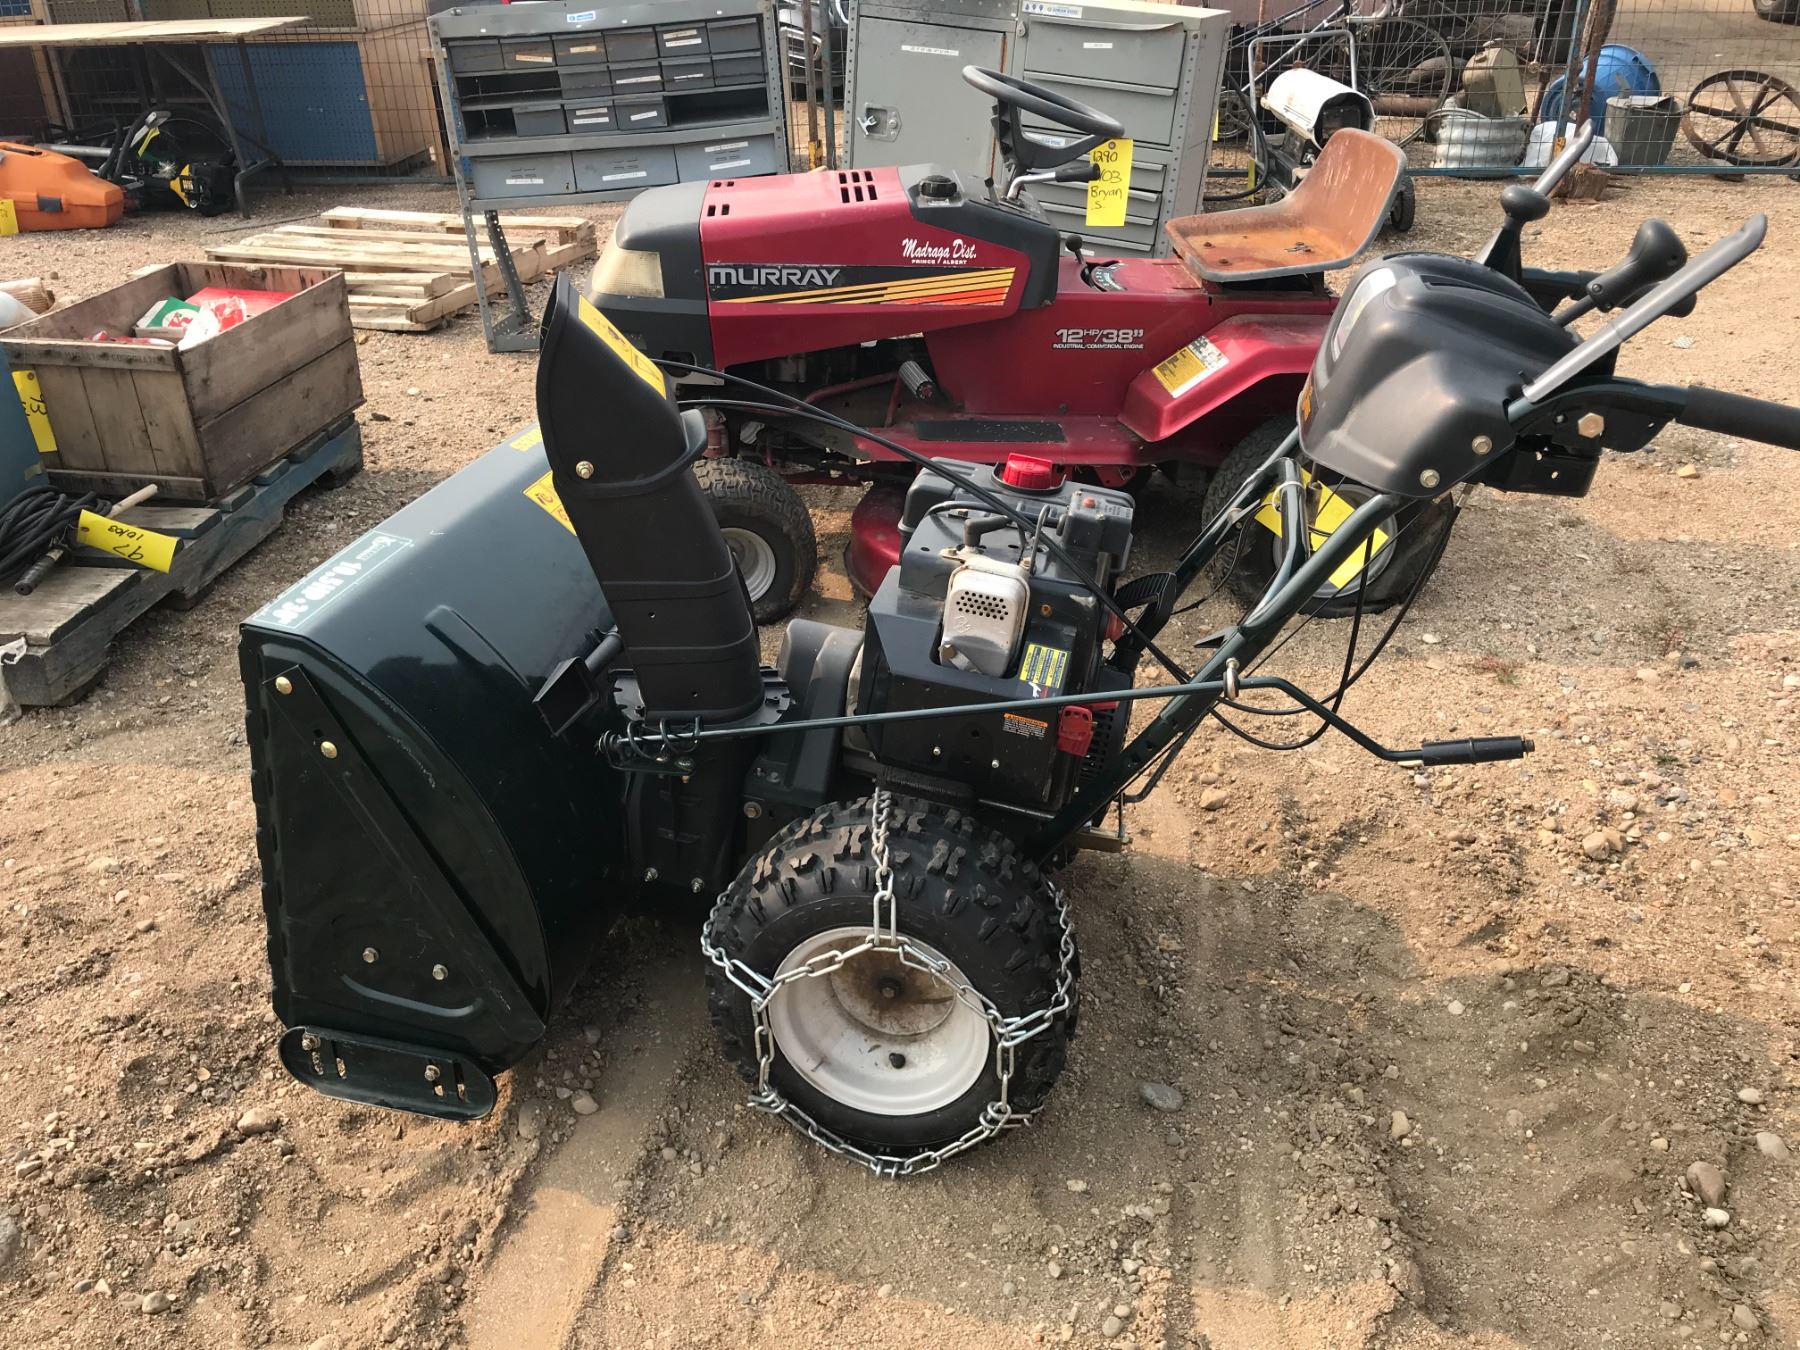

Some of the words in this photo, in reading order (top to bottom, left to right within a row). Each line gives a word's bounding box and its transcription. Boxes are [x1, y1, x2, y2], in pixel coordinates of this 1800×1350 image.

[1093, 150, 1118, 163] 1290
[1090, 185, 1122, 200] Bryan
[902, 238, 951, 262] Madraga
[952, 239, 977, 259] Dist.
[709, 267, 841, 286] MURRAY
